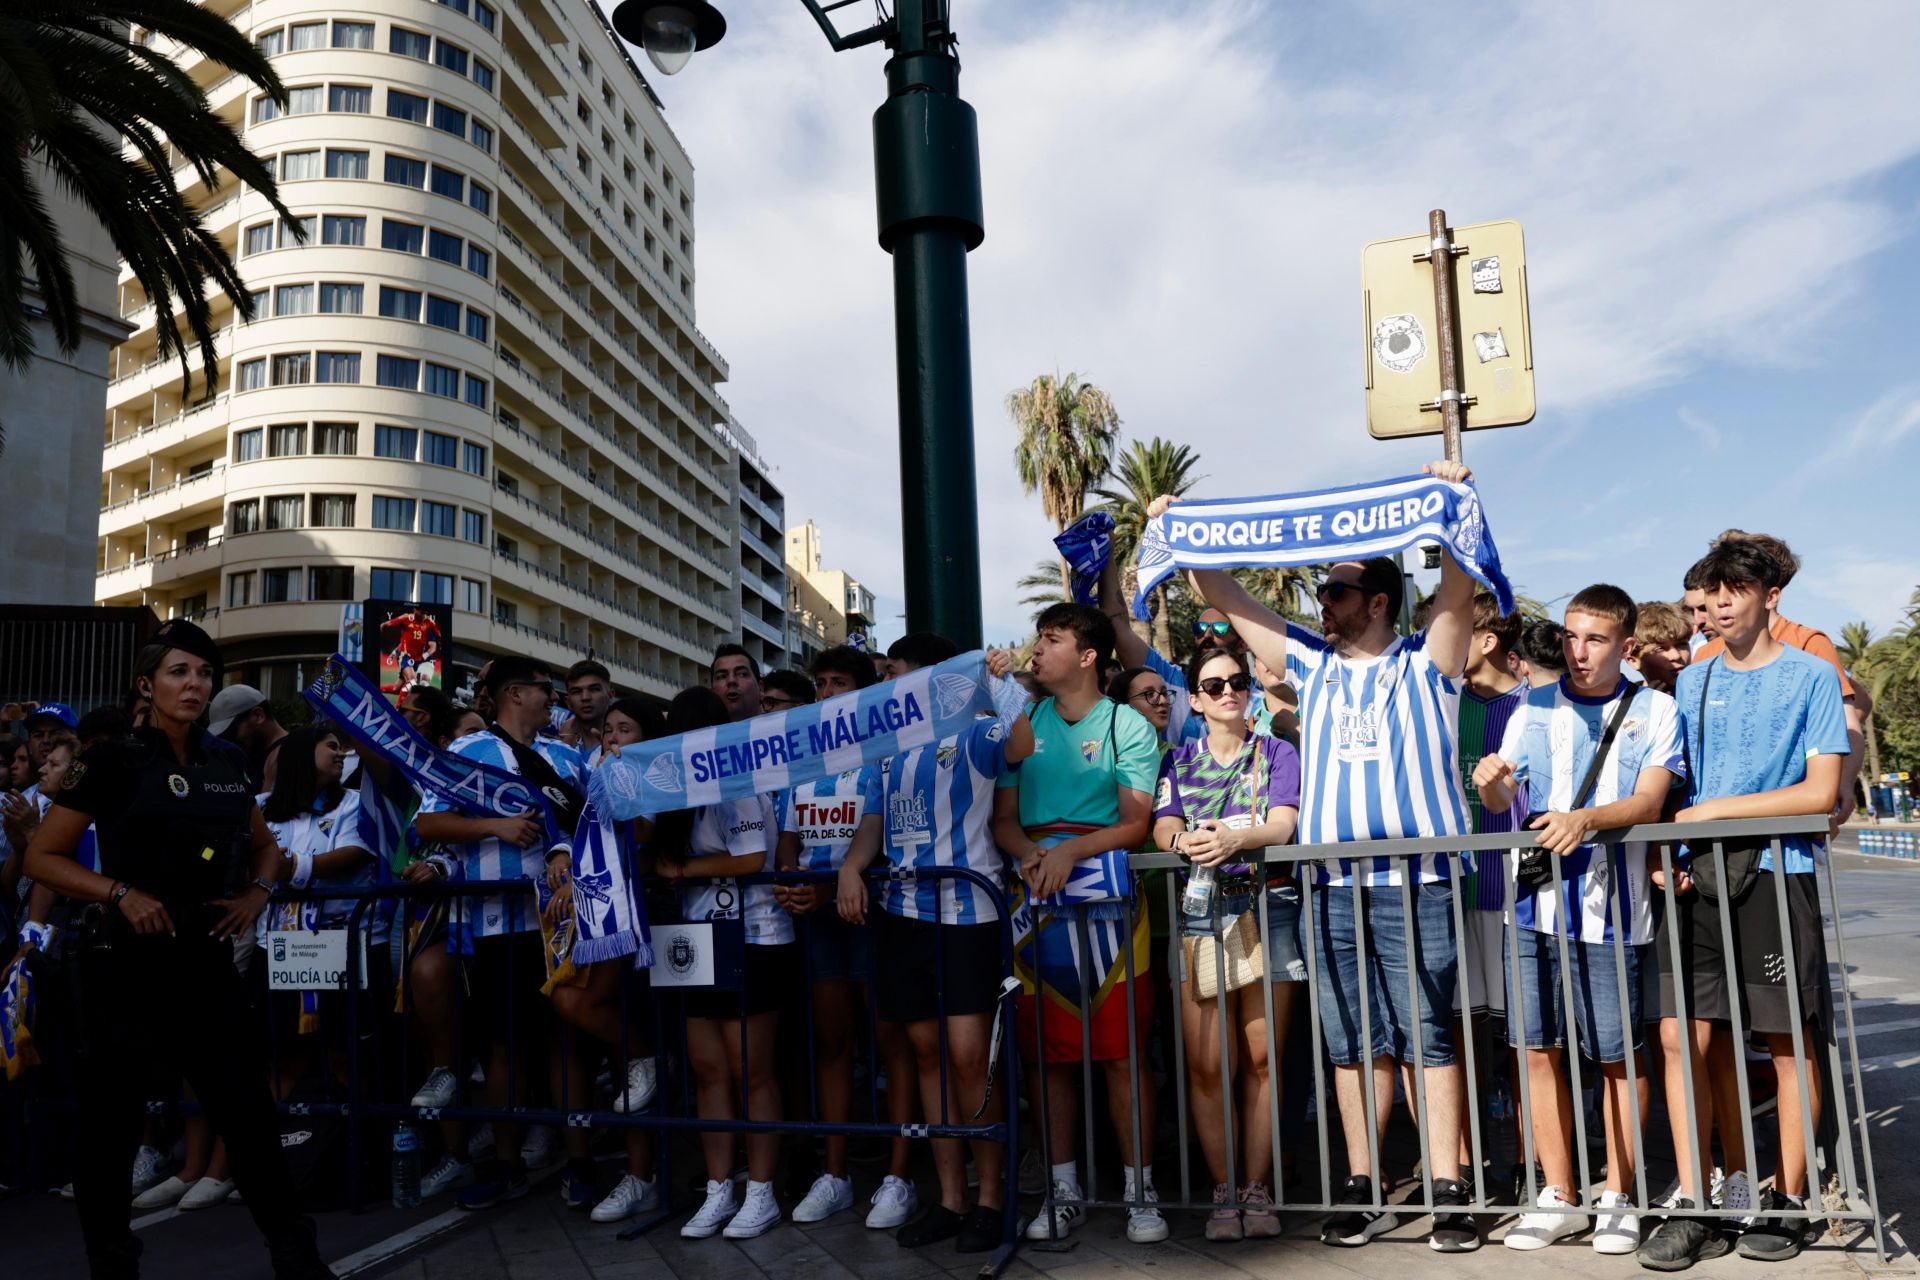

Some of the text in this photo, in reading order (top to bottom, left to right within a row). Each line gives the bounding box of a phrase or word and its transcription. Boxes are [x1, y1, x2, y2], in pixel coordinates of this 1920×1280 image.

[1169, 518, 1284, 547] PORQUE
[1293, 514, 1323, 541] TE
[1331, 490, 1445, 537] QUIERO
[690, 729, 804, 783] SIEMPRE
[808, 692, 924, 755] MÁLAGA
[204, 782, 246, 793] POLICÍA
[796, 801, 856, 827] Tivoli
[821, 828, 837, 839] DEL
[838, 827, 857, 839] SO
[290, 943, 328, 951] Ayuntamiento
[272, 966, 321, 984] POLICÍA
